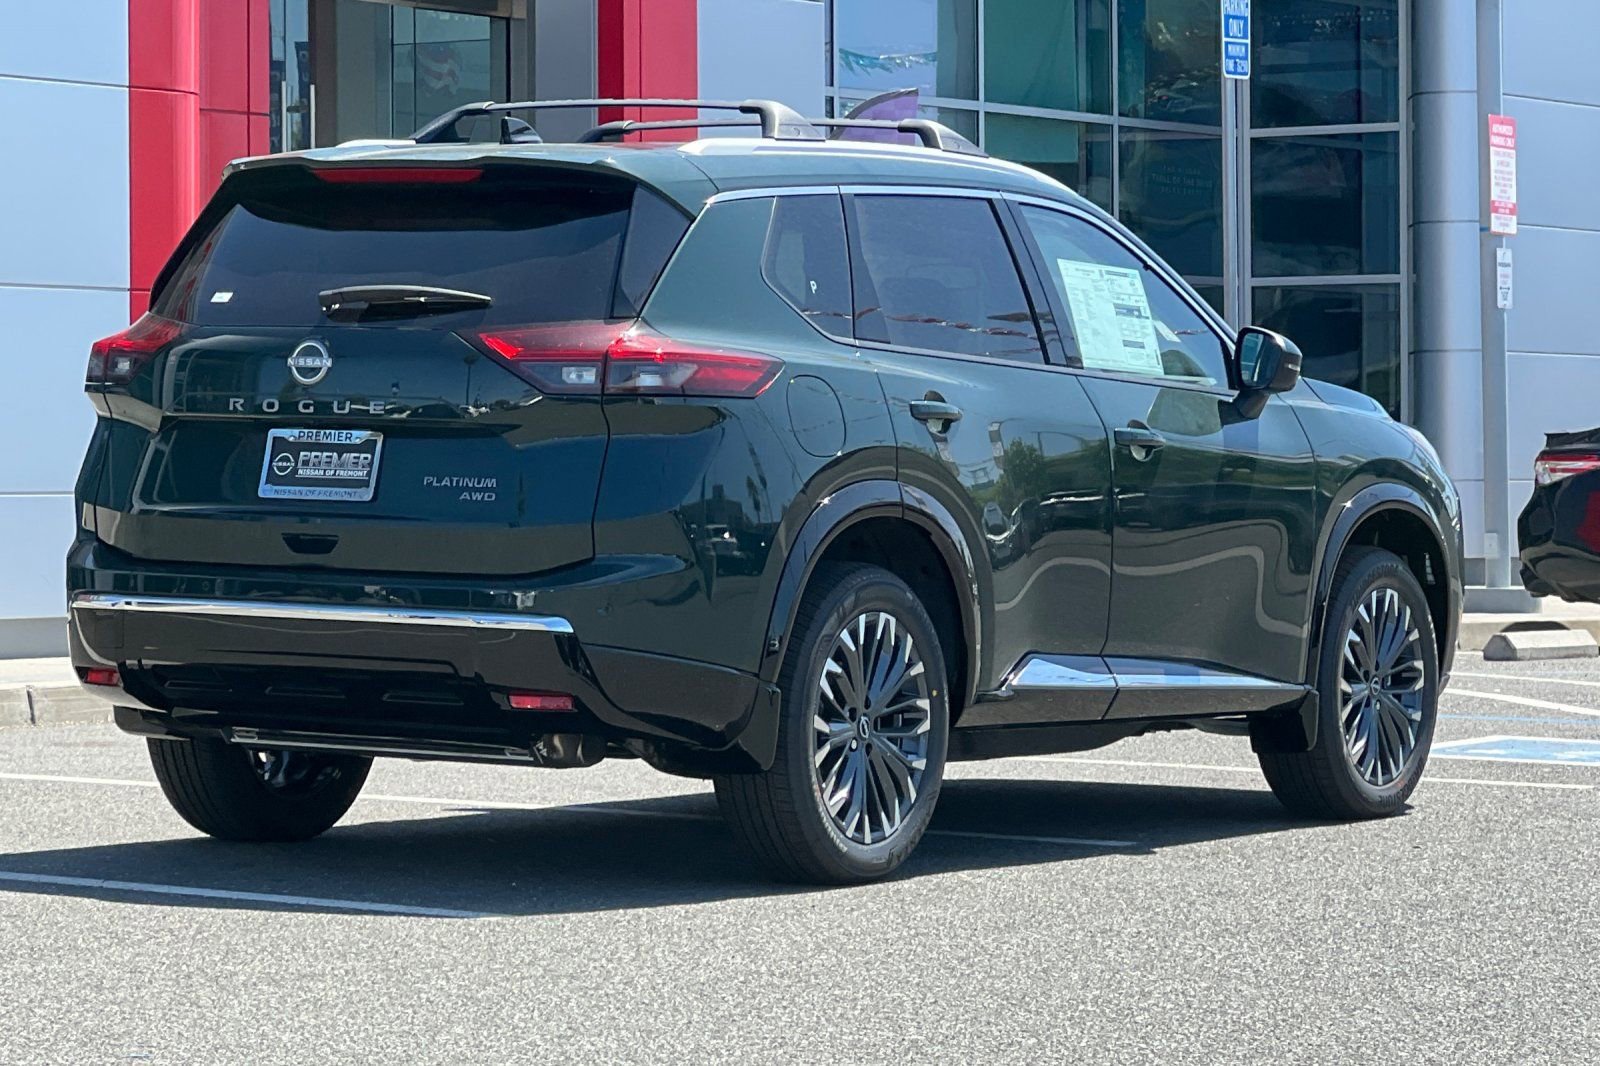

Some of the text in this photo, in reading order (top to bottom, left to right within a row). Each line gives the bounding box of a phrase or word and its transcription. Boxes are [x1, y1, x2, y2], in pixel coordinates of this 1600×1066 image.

[1228, 18, 1244, 37] ONLY
[287, 357, 332, 367] NISSAN
[229, 398, 385, 414] ROGUE
[297, 430, 353, 442] PREMIER
[297, 451, 372, 469] PREMIER
[424, 477, 497, 487] PLATINUM
[273, 488, 303, 496] NISSAN
[459, 492, 496, 501] AWD
